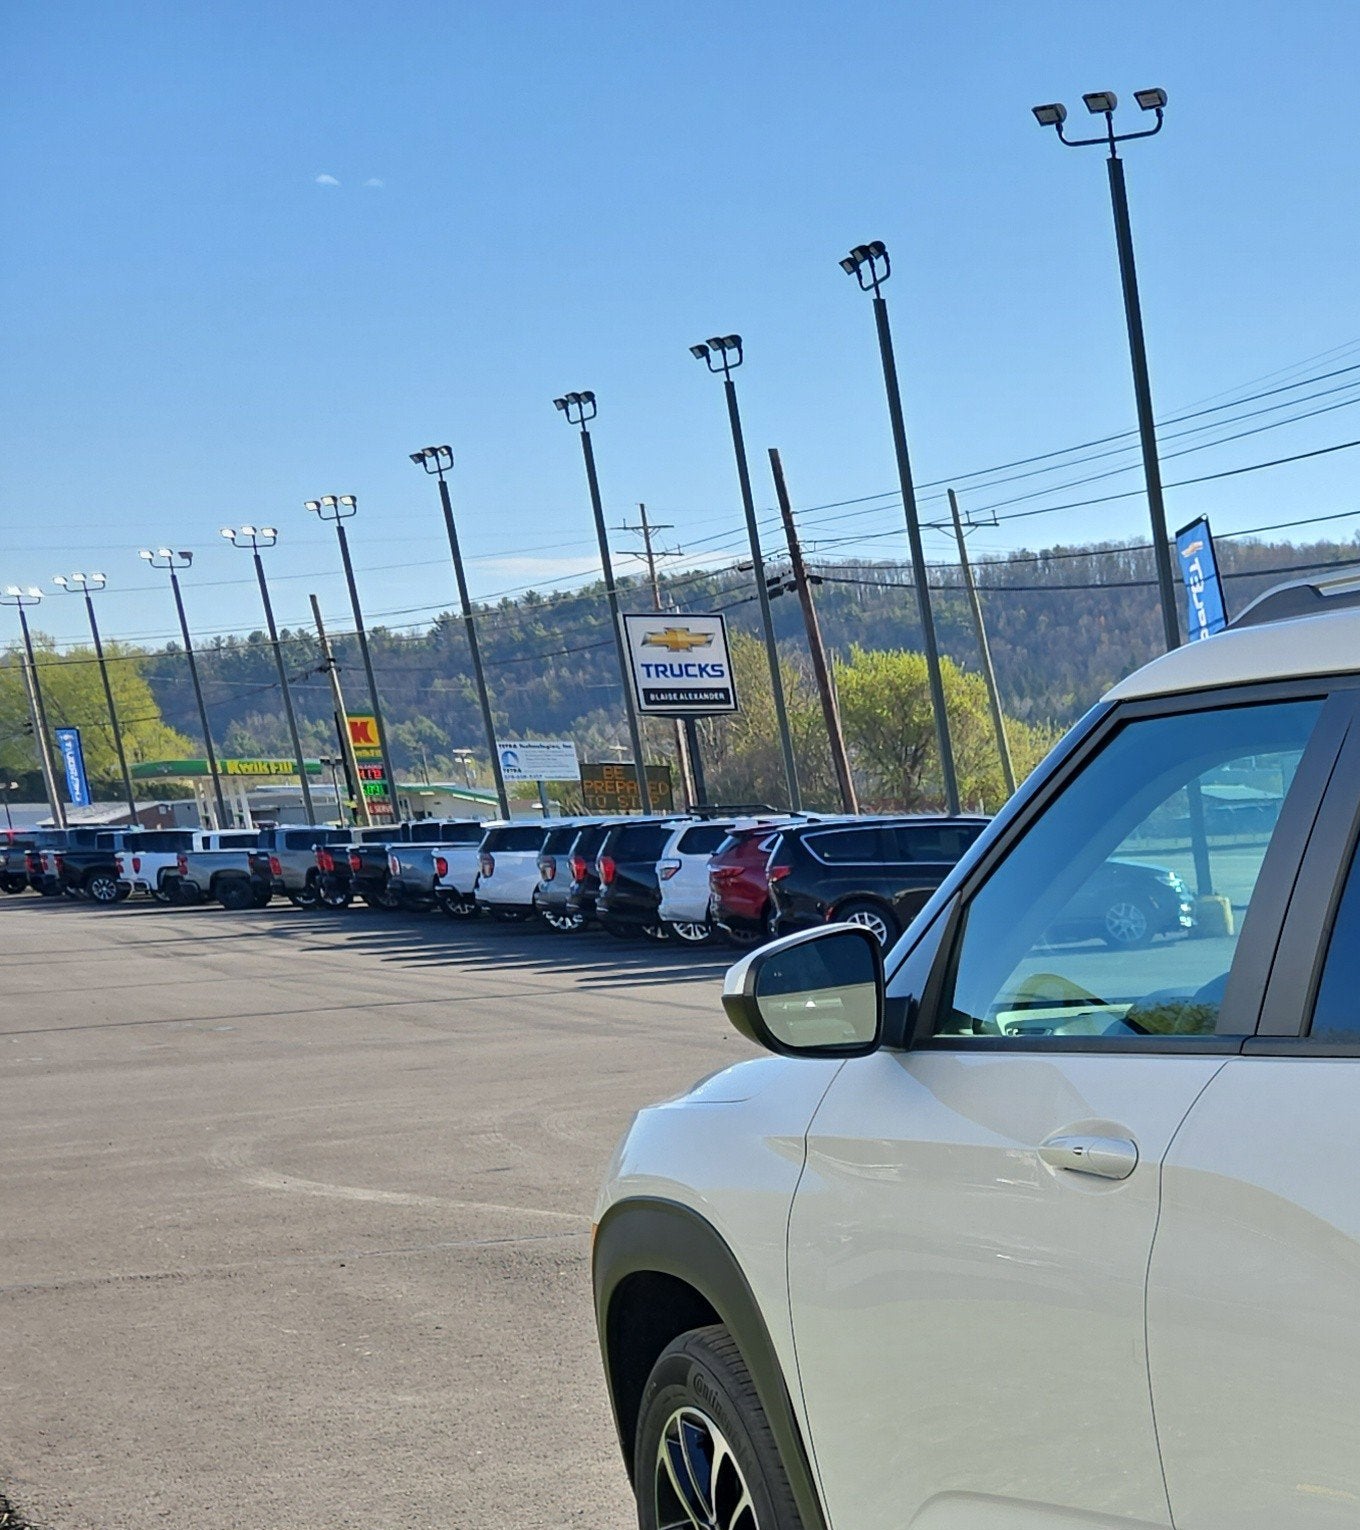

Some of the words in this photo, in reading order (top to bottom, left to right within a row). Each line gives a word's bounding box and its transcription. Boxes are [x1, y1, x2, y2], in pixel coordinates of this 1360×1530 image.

[640, 663, 725, 679] TRUCKS
[649, 692, 678, 701] BLAISE
[679, 692, 726, 701] ALEXANDER
[349, 721, 375, 743] K
[226, 760, 270, 775] Kwik
[270, 761, 293, 774] Fill
[603, 766, 625, 780] BE
[584, 779, 669, 796] PREPAED
[585, 795, 607, 808] TO
[618, 792, 661, 808] STP
